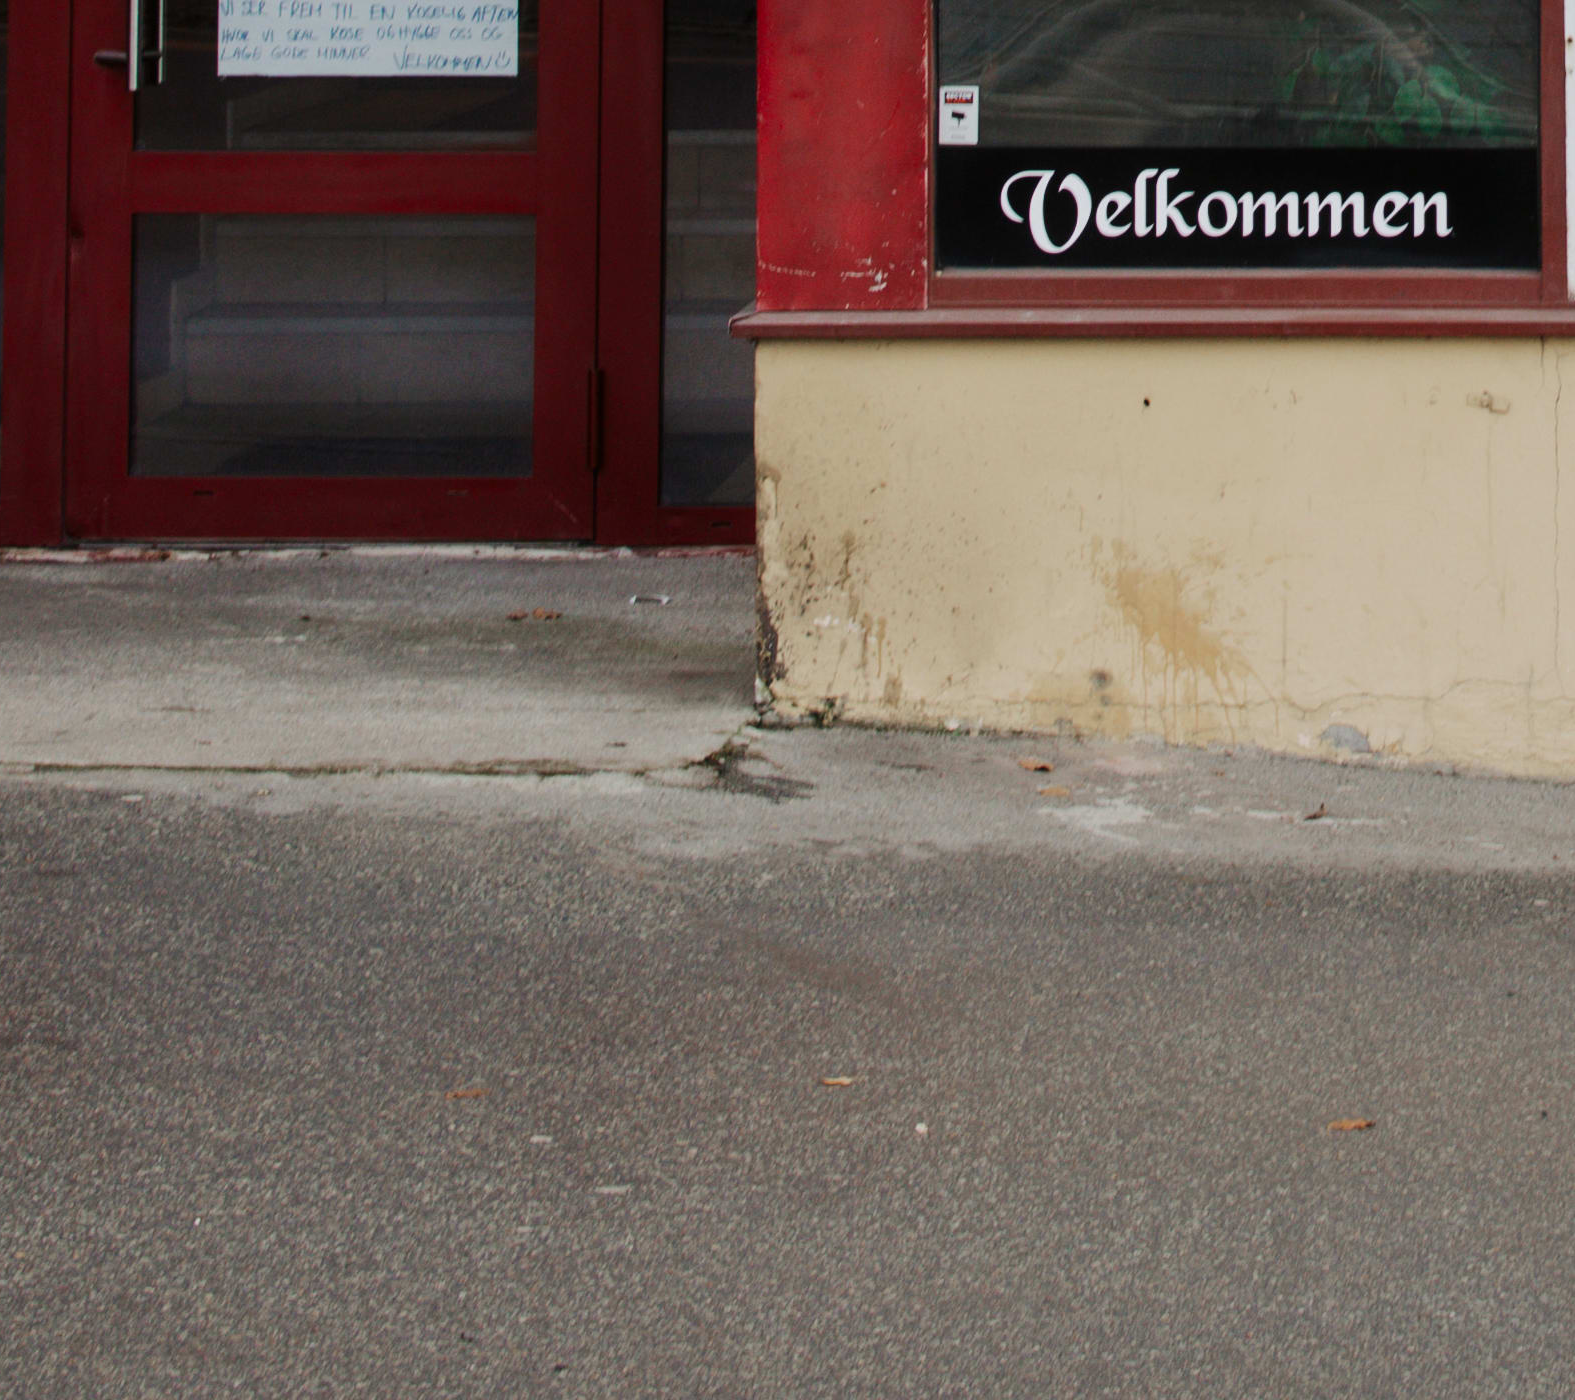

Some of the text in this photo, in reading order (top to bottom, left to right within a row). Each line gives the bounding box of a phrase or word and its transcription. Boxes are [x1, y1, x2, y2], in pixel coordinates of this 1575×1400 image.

[331, 2, 361, 21] TIL
[369, 3, 397, 21] EN
[1000, 168, 1454, 255] Velkommen
